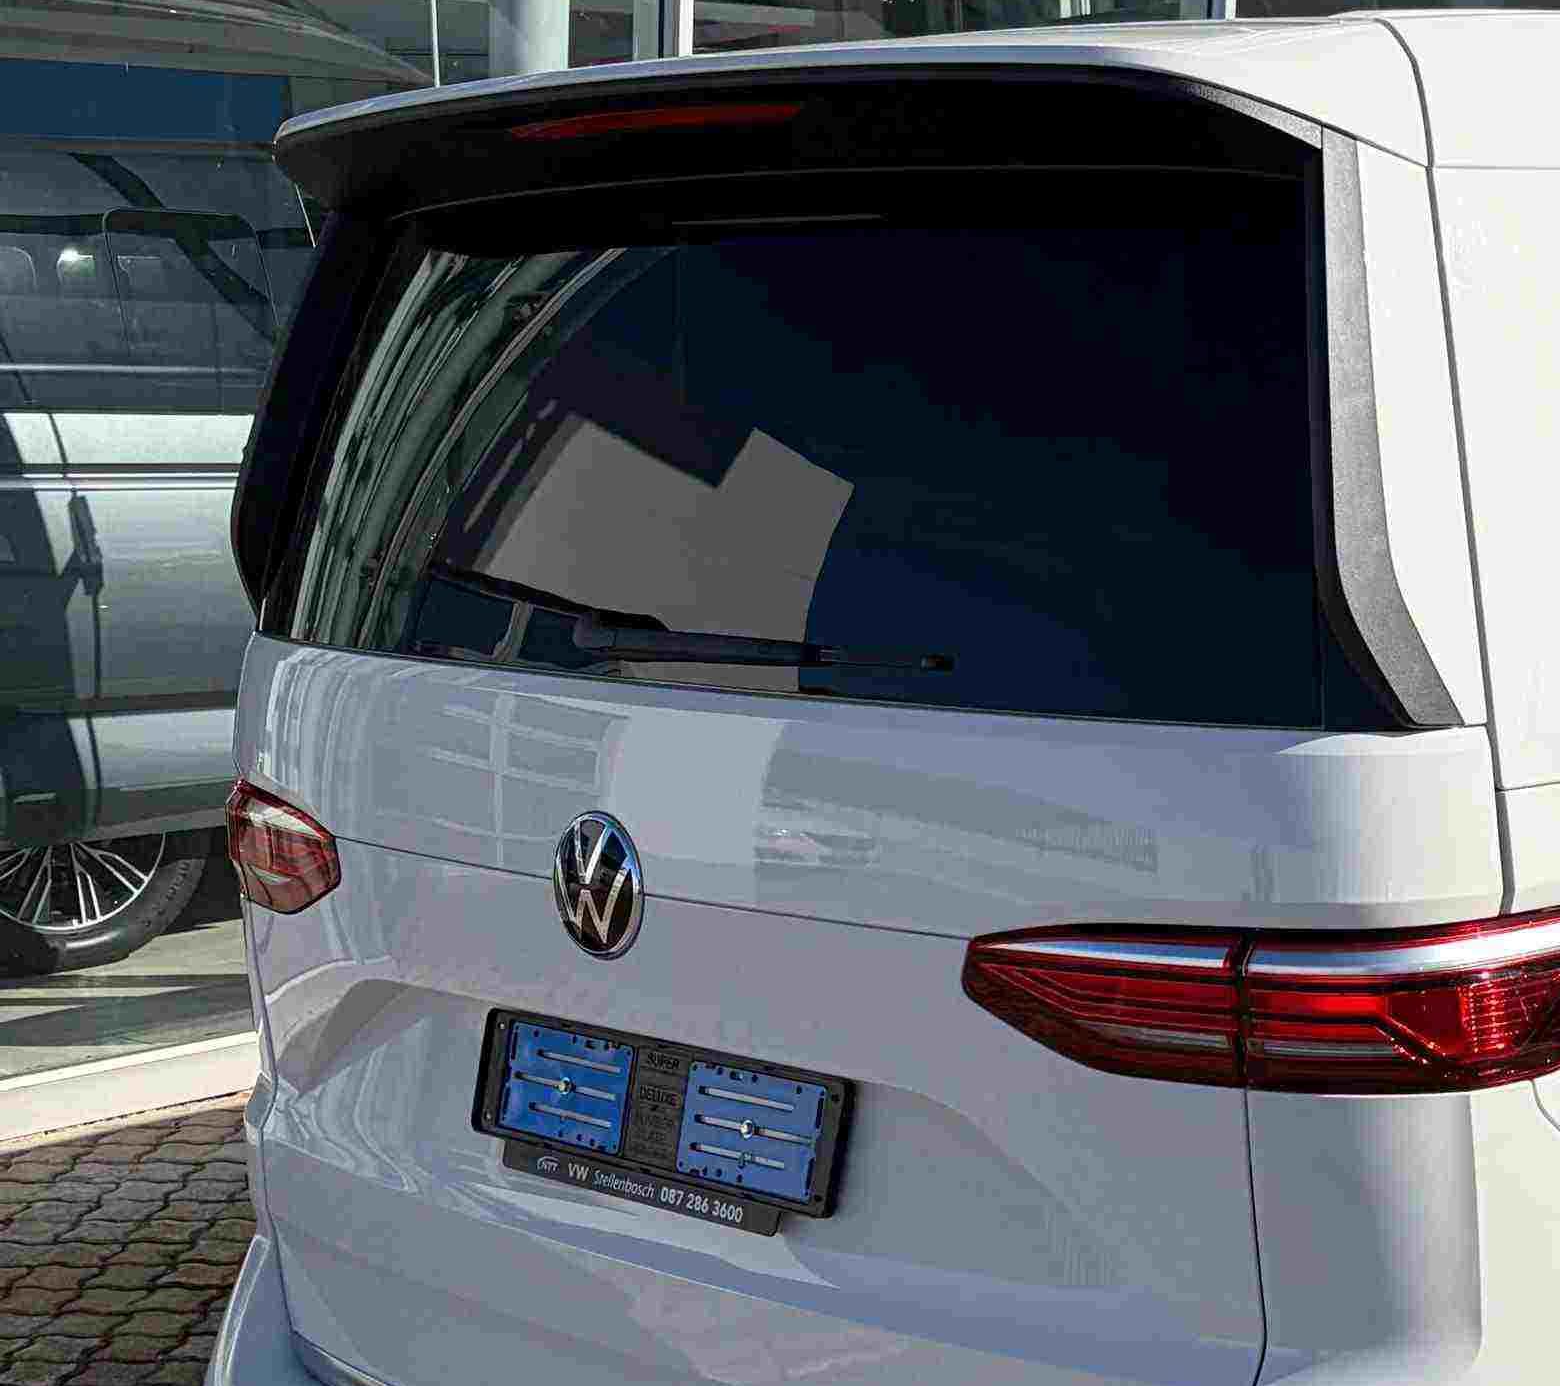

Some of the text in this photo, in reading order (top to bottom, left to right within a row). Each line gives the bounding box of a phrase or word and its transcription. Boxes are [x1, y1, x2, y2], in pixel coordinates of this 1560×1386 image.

[553, 811, 644, 960] VW
[567, 1163, 591, 1182] VW
[593, 1168, 655, 1199] Stellenbosch
[659, 1185, 685, 1206] 087
[686, 1192, 709, 1214] 286
[711, 1200, 744, 1223] 3600
